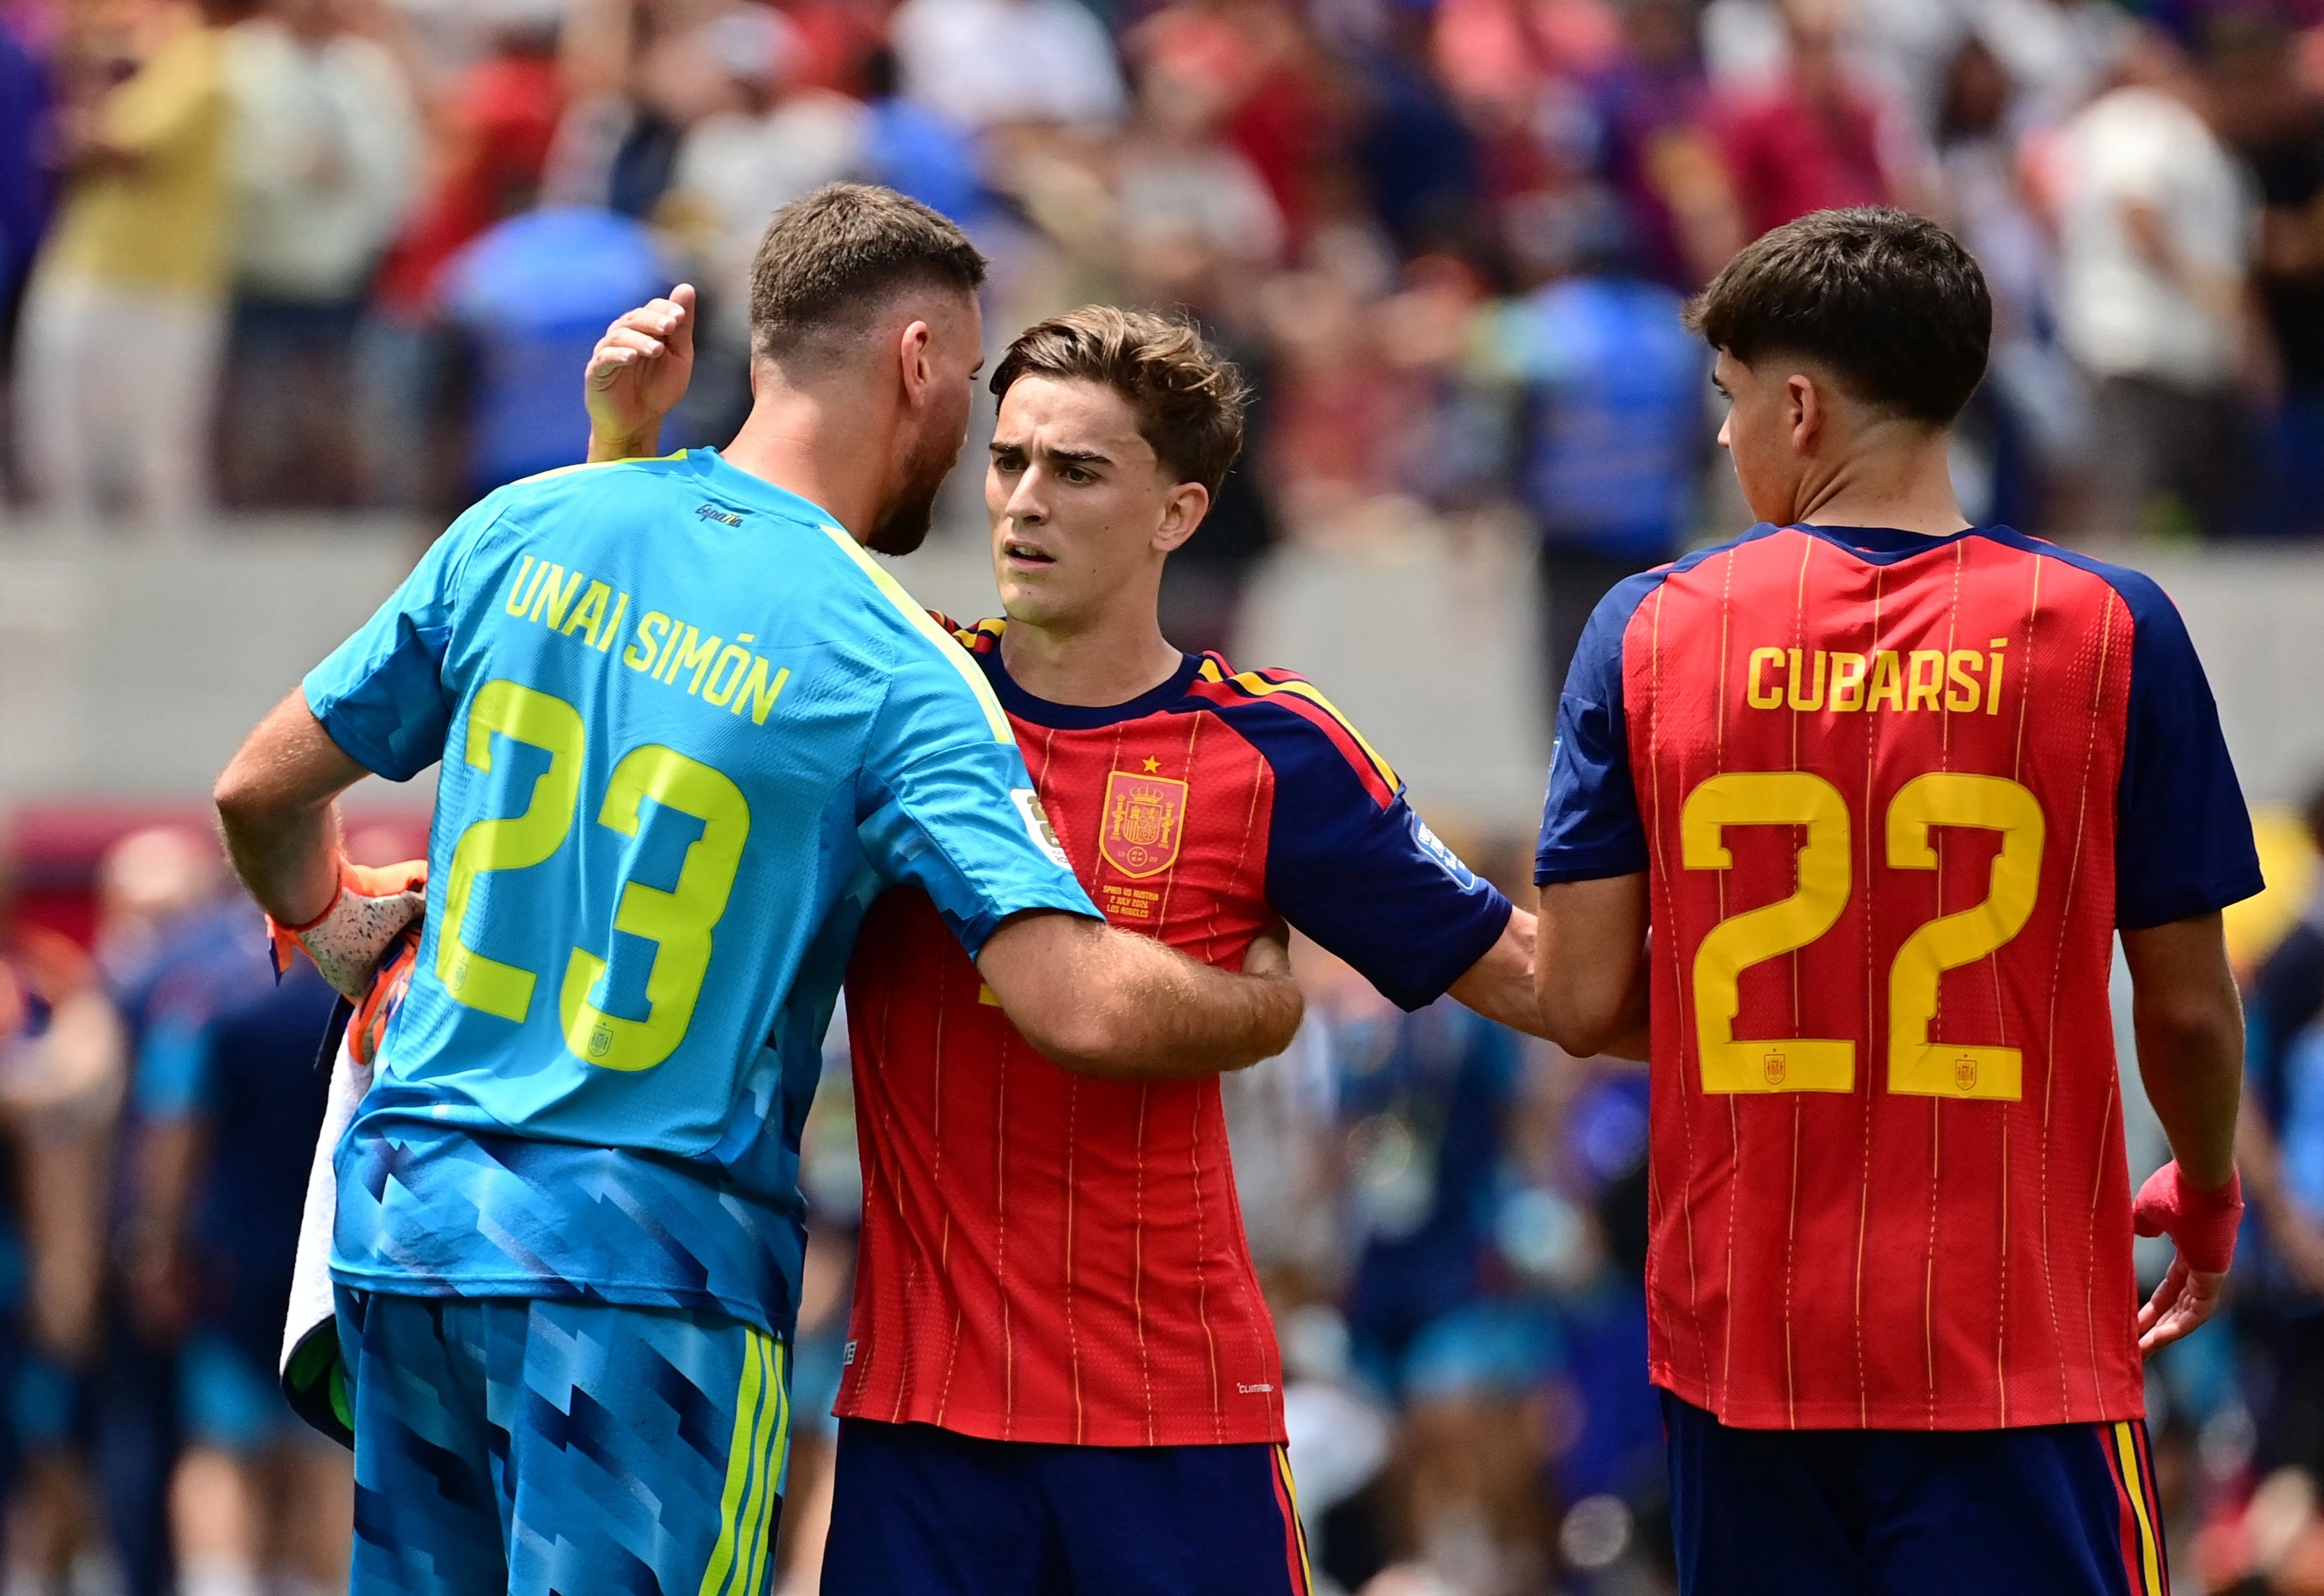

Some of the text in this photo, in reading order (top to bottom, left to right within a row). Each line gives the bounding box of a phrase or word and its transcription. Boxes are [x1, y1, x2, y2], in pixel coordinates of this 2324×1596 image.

[695, 503, 743, 528] España
[506, 556, 790, 726] UNAI SIMÓN
[1747, 638, 2008, 715] CUBARSÍ
[435, 679, 750, 1071] 23
[1102, 885, 1122, 895] SPAIN
[1133, 890, 1159, 901] AUSTRIA
[1106, 904, 1149, 918] LOS ANGELES
[1110, 895, 1149, 909] 2 JULY 2026
[1681, 771, 2045, 1101] 22
